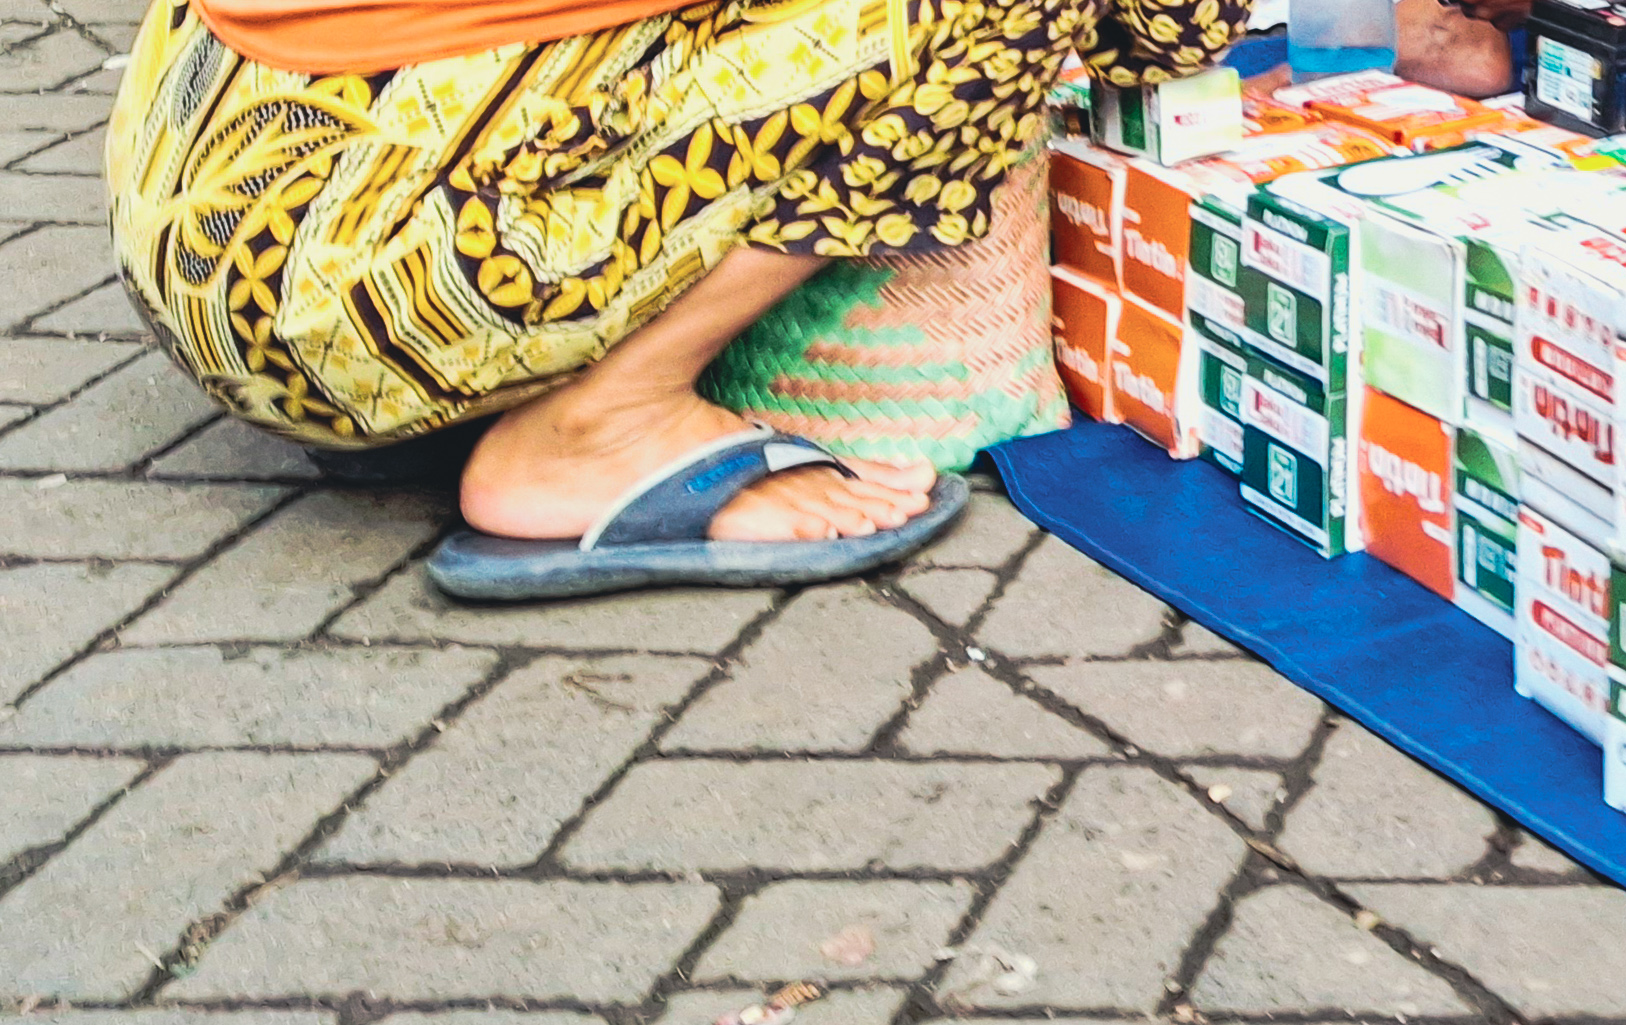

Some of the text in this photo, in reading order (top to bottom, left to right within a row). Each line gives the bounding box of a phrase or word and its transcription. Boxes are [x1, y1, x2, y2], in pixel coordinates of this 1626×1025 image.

[1123, 228, 1177, 279] Tintin
[1112, 360, 1165, 414] Tintin
[1367, 441, 1445, 515] Tintin
